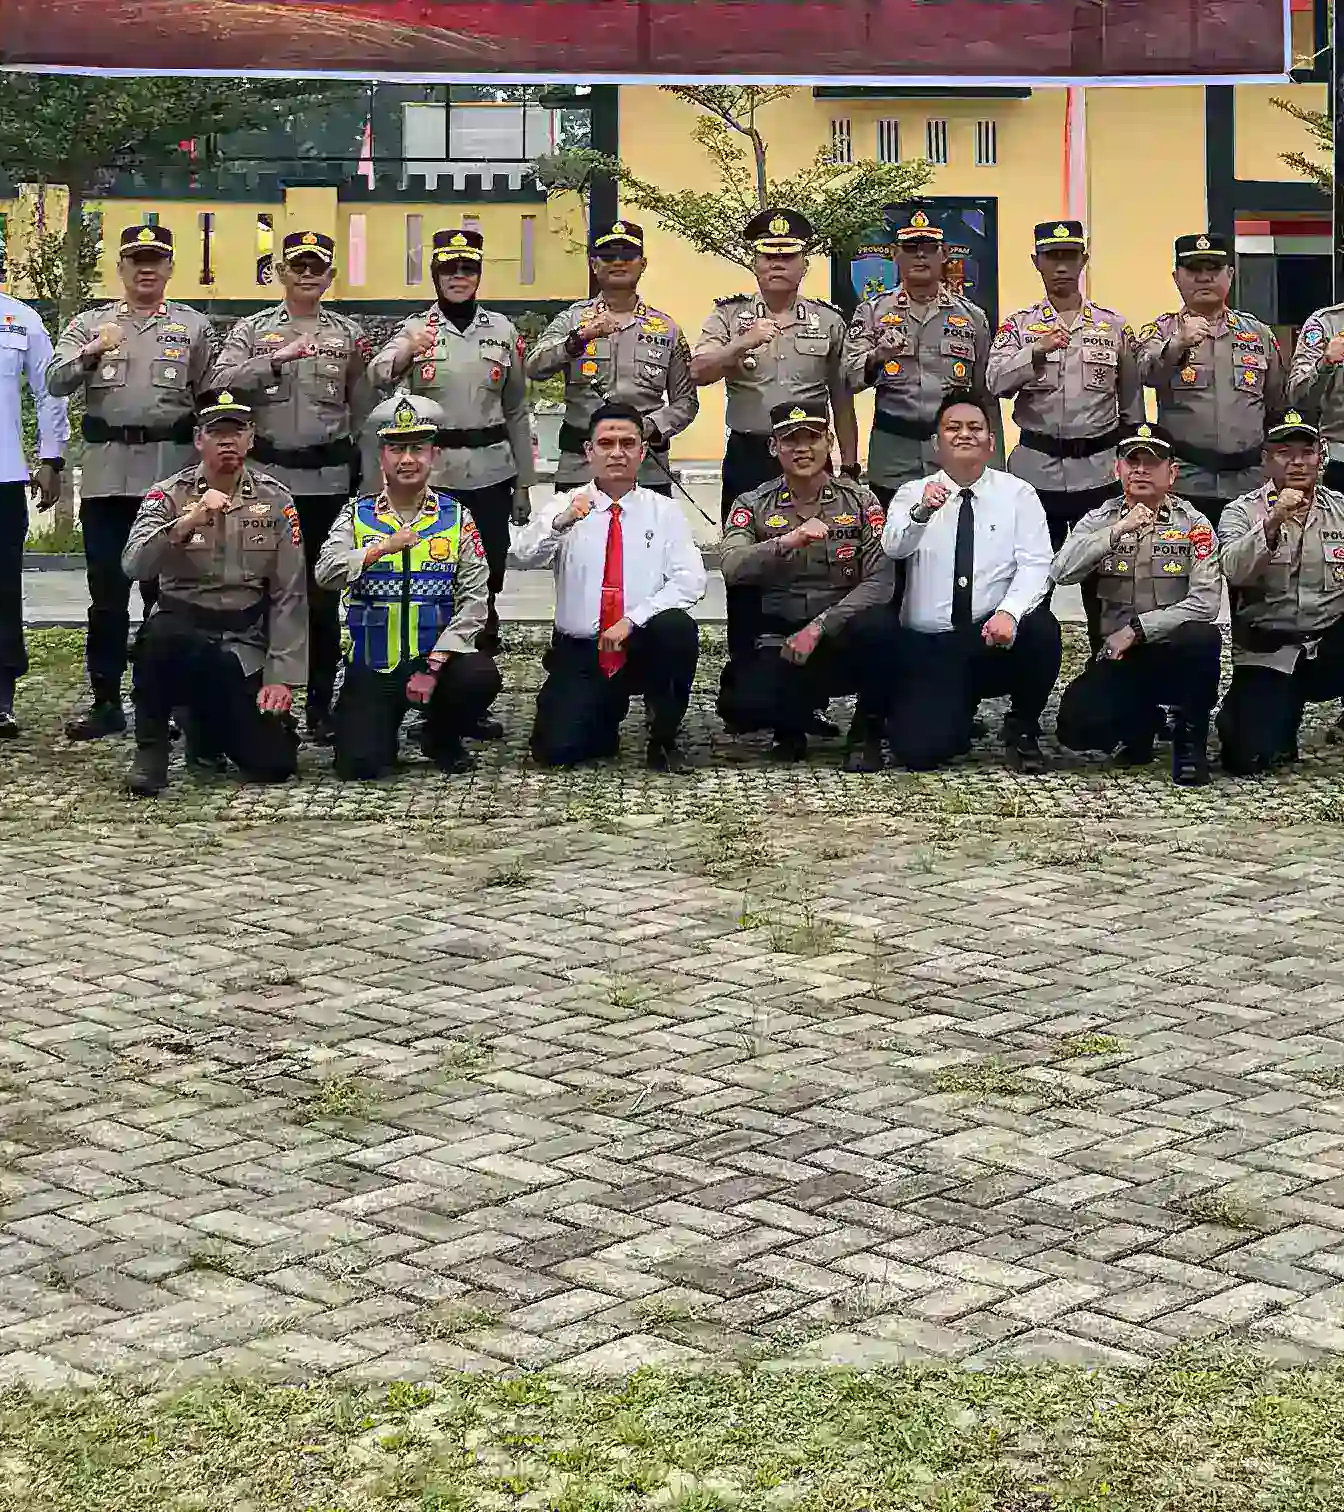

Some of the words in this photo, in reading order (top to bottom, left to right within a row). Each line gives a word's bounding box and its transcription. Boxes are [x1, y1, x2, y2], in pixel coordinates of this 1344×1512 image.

[157, 335, 191, 346] POLRI
[638, 334, 671, 348] POLRI
[1083, 337, 1115, 348] POLRI
[1232, 342, 1265, 354] POLRI
[1154, 543, 1191, 555] POLRI
